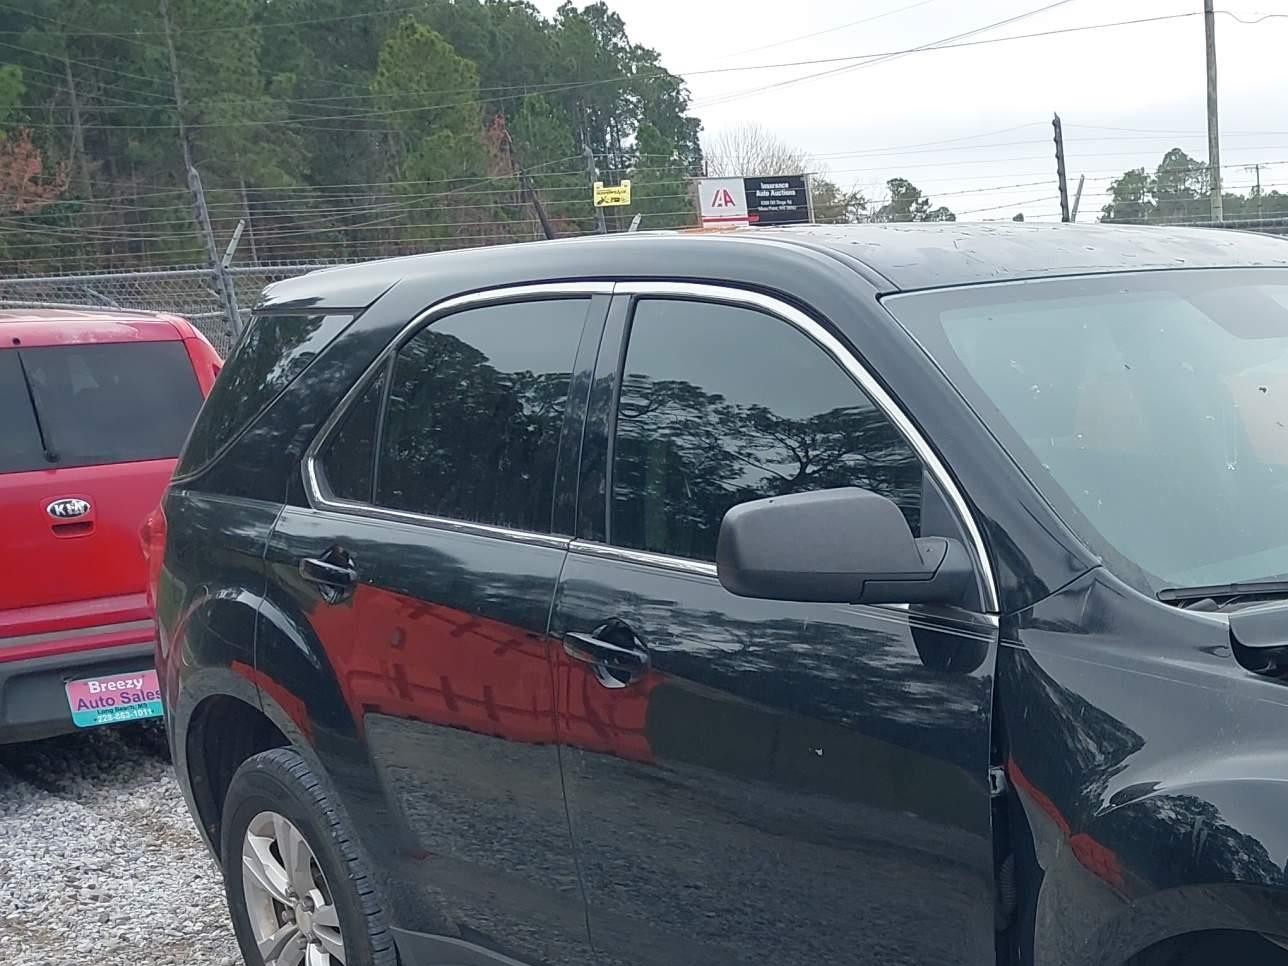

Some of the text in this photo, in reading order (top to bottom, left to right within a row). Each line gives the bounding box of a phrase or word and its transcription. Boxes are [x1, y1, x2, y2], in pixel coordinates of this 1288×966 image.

[53, 500, 85, 516] KIA
[88, 678, 143, 694] Breezy
[78, 689, 160, 711] Auto Sales
[97, 708, 114, 716] Long
